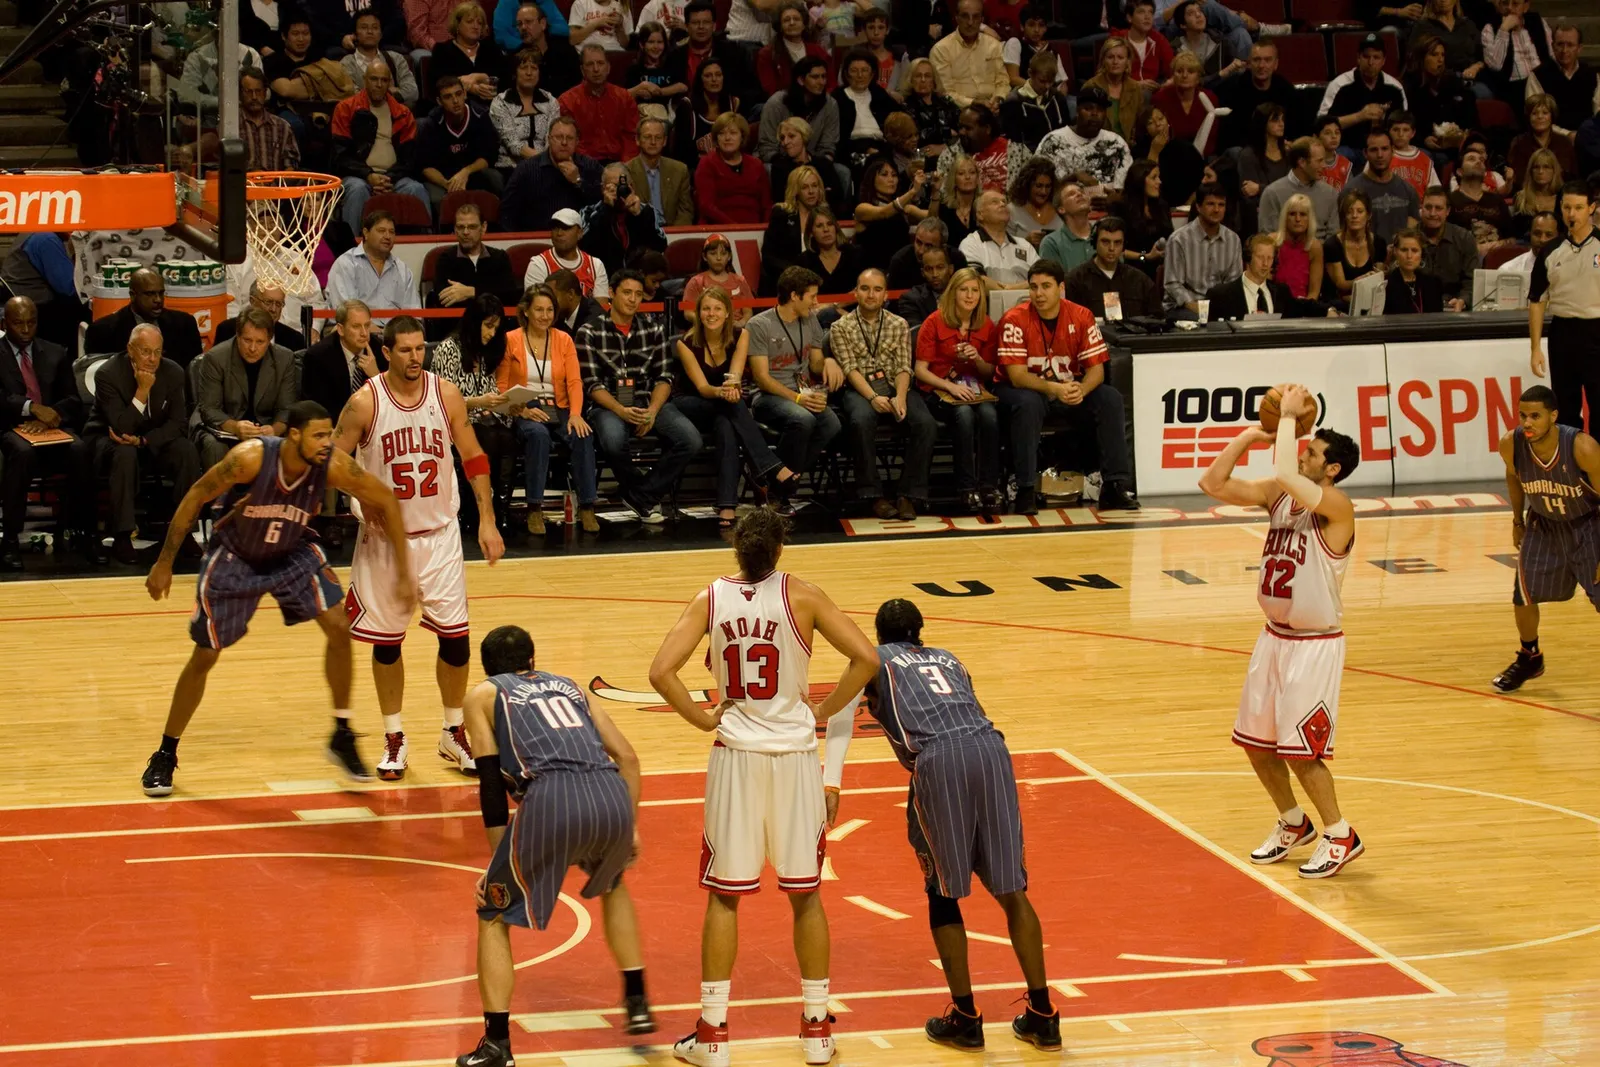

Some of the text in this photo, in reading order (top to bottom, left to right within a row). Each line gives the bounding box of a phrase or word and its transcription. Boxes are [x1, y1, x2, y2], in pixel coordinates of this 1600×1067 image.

[1003, 323, 1024, 344] 28
[1357, 376, 1522, 462] ESPN
[381, 426, 445, 465] BULLS
[1161, 425, 1312, 469] ESP
[391, 459, 439, 500] 52
[1542, 495, 1567, 516] 14
[264, 521, 284, 544] 6
[1262, 527, 1307, 566] BULLS
[1261, 557, 1296, 600] 12
[719, 616, 779, 643] NOAH
[722, 643, 780, 701] 13
[891, 651, 957, 671] WALLACE
[918, 665, 953, 696] 3
[529, 695, 584, 730] 10
[708, 1043, 719, 1053] 13
[821, 1038, 829, 1048] 13
